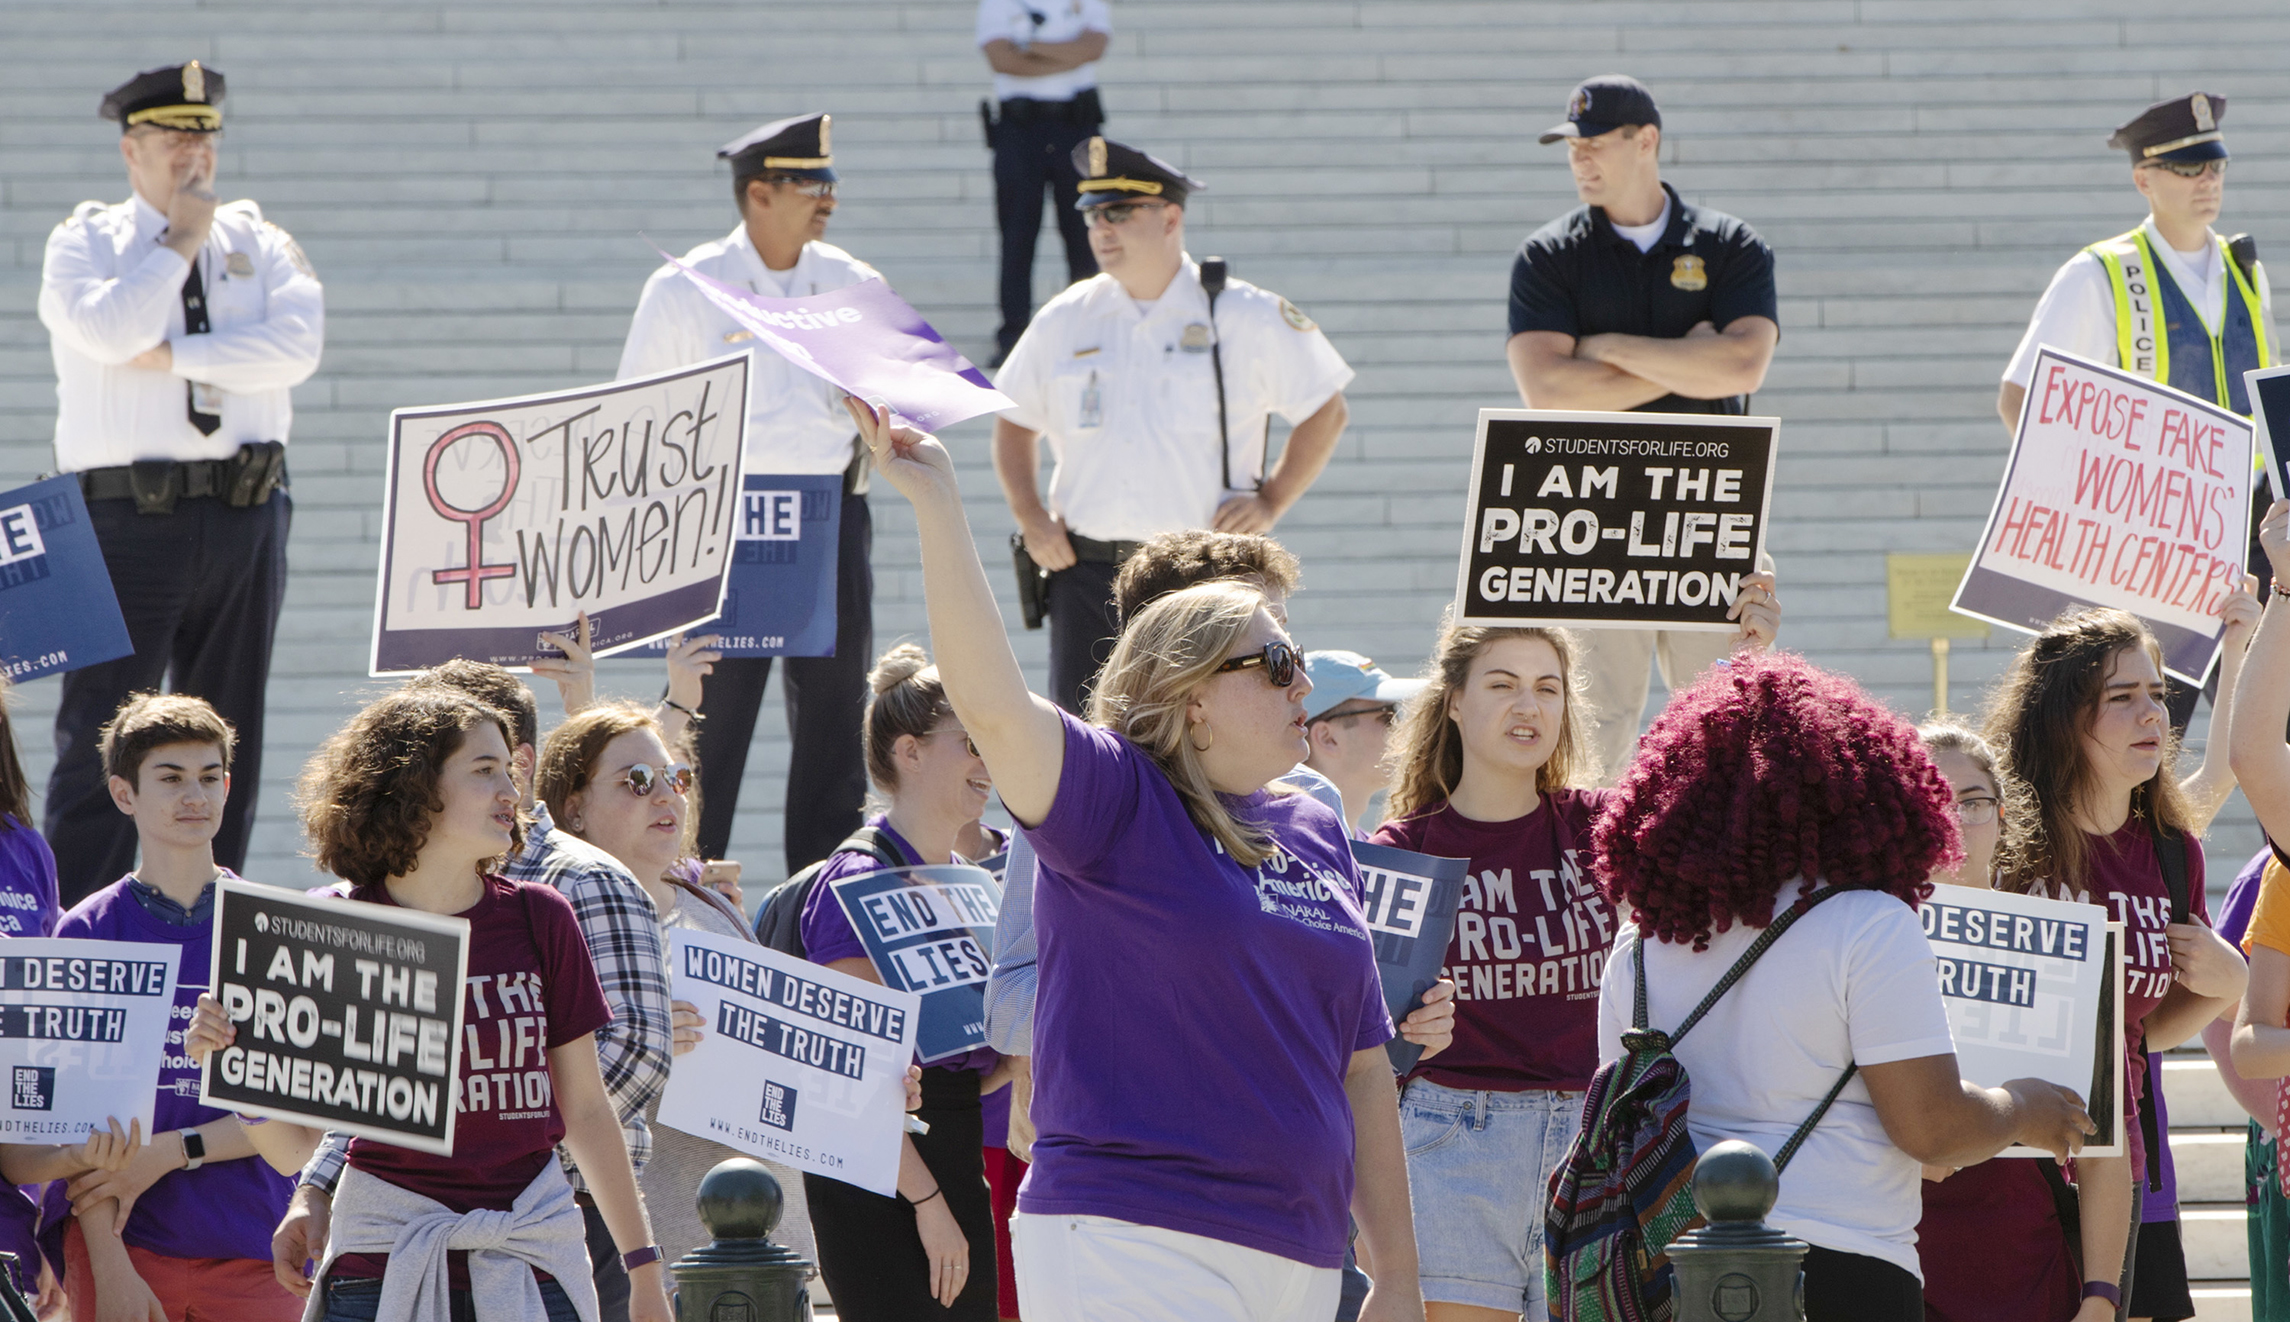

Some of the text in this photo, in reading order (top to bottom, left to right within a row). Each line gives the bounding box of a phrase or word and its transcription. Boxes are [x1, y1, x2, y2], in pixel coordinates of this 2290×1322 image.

[2126, 265, 2153, 372] POLICE
[1544, 438, 1730, 458] STUDENTSFORLIFE.ORG
[2038, 366, 2226, 480] EXPOSE FAKE
[1500, 463, 1744, 503] I AM THE
[744, 494, 793, 536] HE
[1479, 507, 1754, 560] PRO-LIFE
[1994, 496, 2242, 617] HEALTH CENTERS
[1479, 565, 1741, 608] GENERATION
[1361, 869, 1424, 931] HE
[1458, 867, 1518, 914] AM
[1529, 849, 1595, 912] THE
[863, 886, 998, 938] END THE
[1281, 903, 1331, 921] NARAL
[1333, 921, 1367, 942] America
[1449, 895, 1613, 962] RO-LIFE
[1917, 903, 2085, 959] DESERVE
[271, 915, 426, 965] STUDENTSFORLIFE.ORG
[893, 939, 988, 993] LIES
[23, 957, 165, 994] DESERVE
[235, 937, 438, 1014] I AM THE
[466, 971, 545, 1019] THE
[687, 946, 903, 1041] WOMEN DESERVE
[1440, 946, 1613, 1001] ENERATIO
[1939, 959, 2031, 1006] RUTH
[23, 1006, 123, 1041] TRUTH
[222, 982, 448, 1078] PRO-LIFE
[464, 1016, 548, 1071] LIFE
[722, 1002, 863, 1078] THE TRUTH
[14, 1082, 39, 1095] THE
[14, 1094, 45, 1108] LIES
[15, 1068, 39, 1082] END
[220, 1045, 439, 1127] GENERATION
[765, 1082, 785, 1101] END
[761, 1109, 787, 1127] LIES
[764, 1096, 783, 1115] THE
[709, 1116, 844, 1169] WWW.ENDTHELIES.COM
